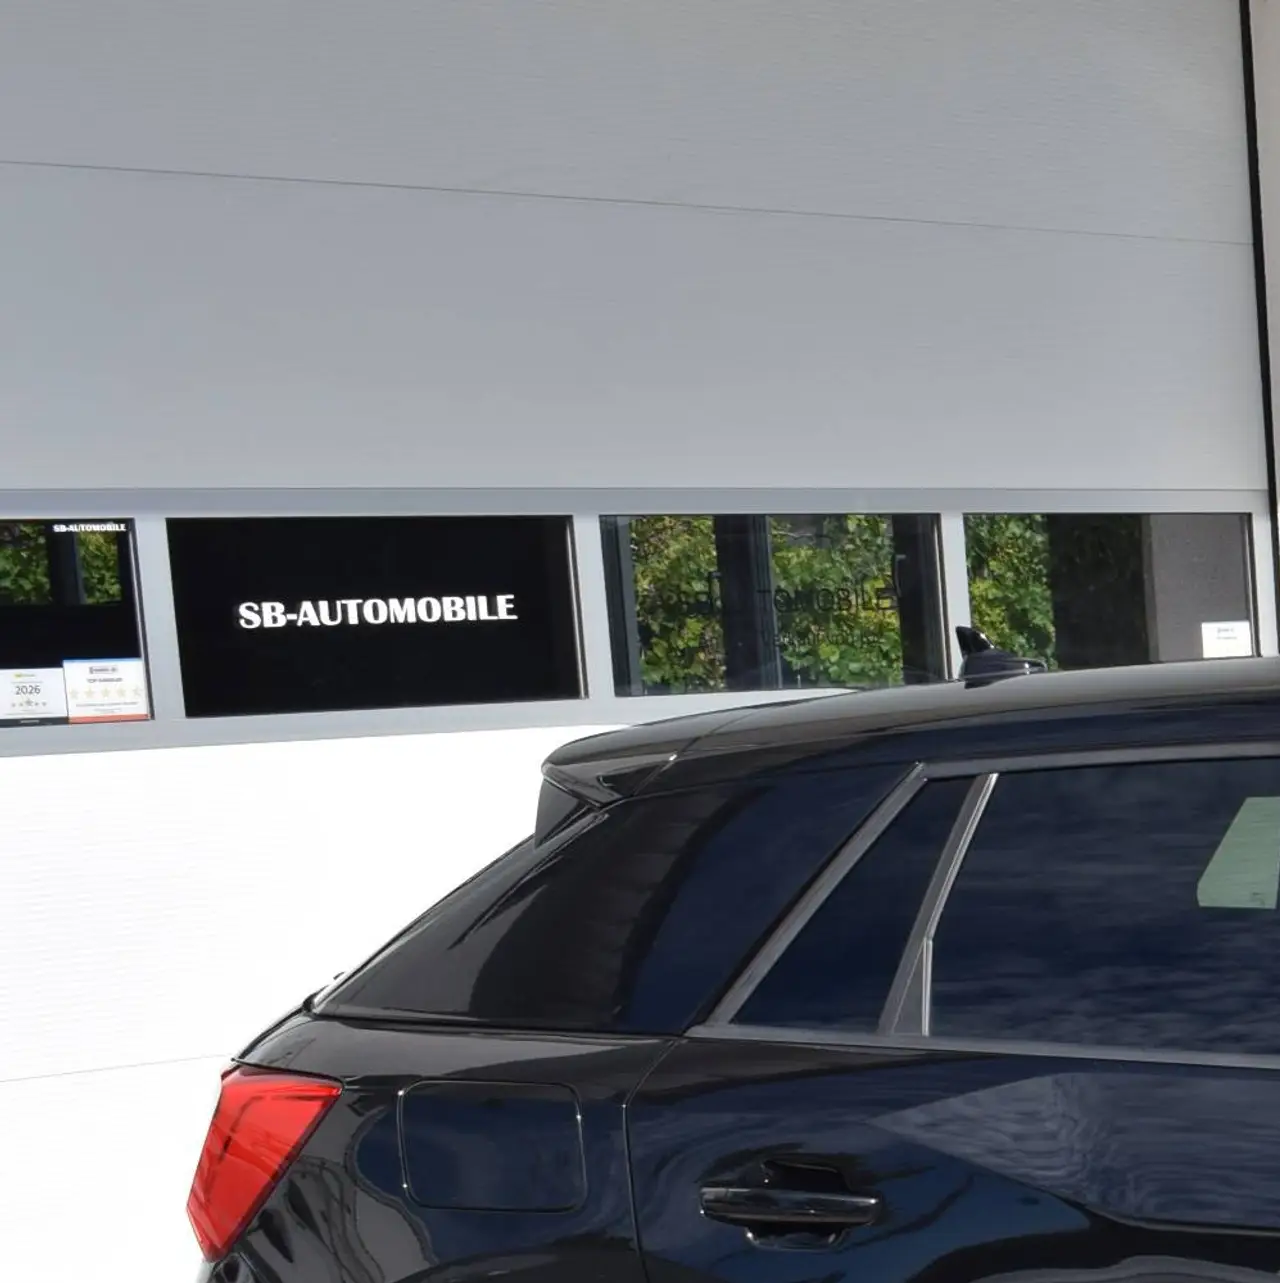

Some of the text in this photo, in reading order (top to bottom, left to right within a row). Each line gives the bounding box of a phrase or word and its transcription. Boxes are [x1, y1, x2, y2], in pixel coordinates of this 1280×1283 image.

[53, 523, 126, 533] SB-AUTOMOBILE
[238, 594, 518, 629] SB-AUTOMOBILE
[15, 685, 41, 696] 2026
